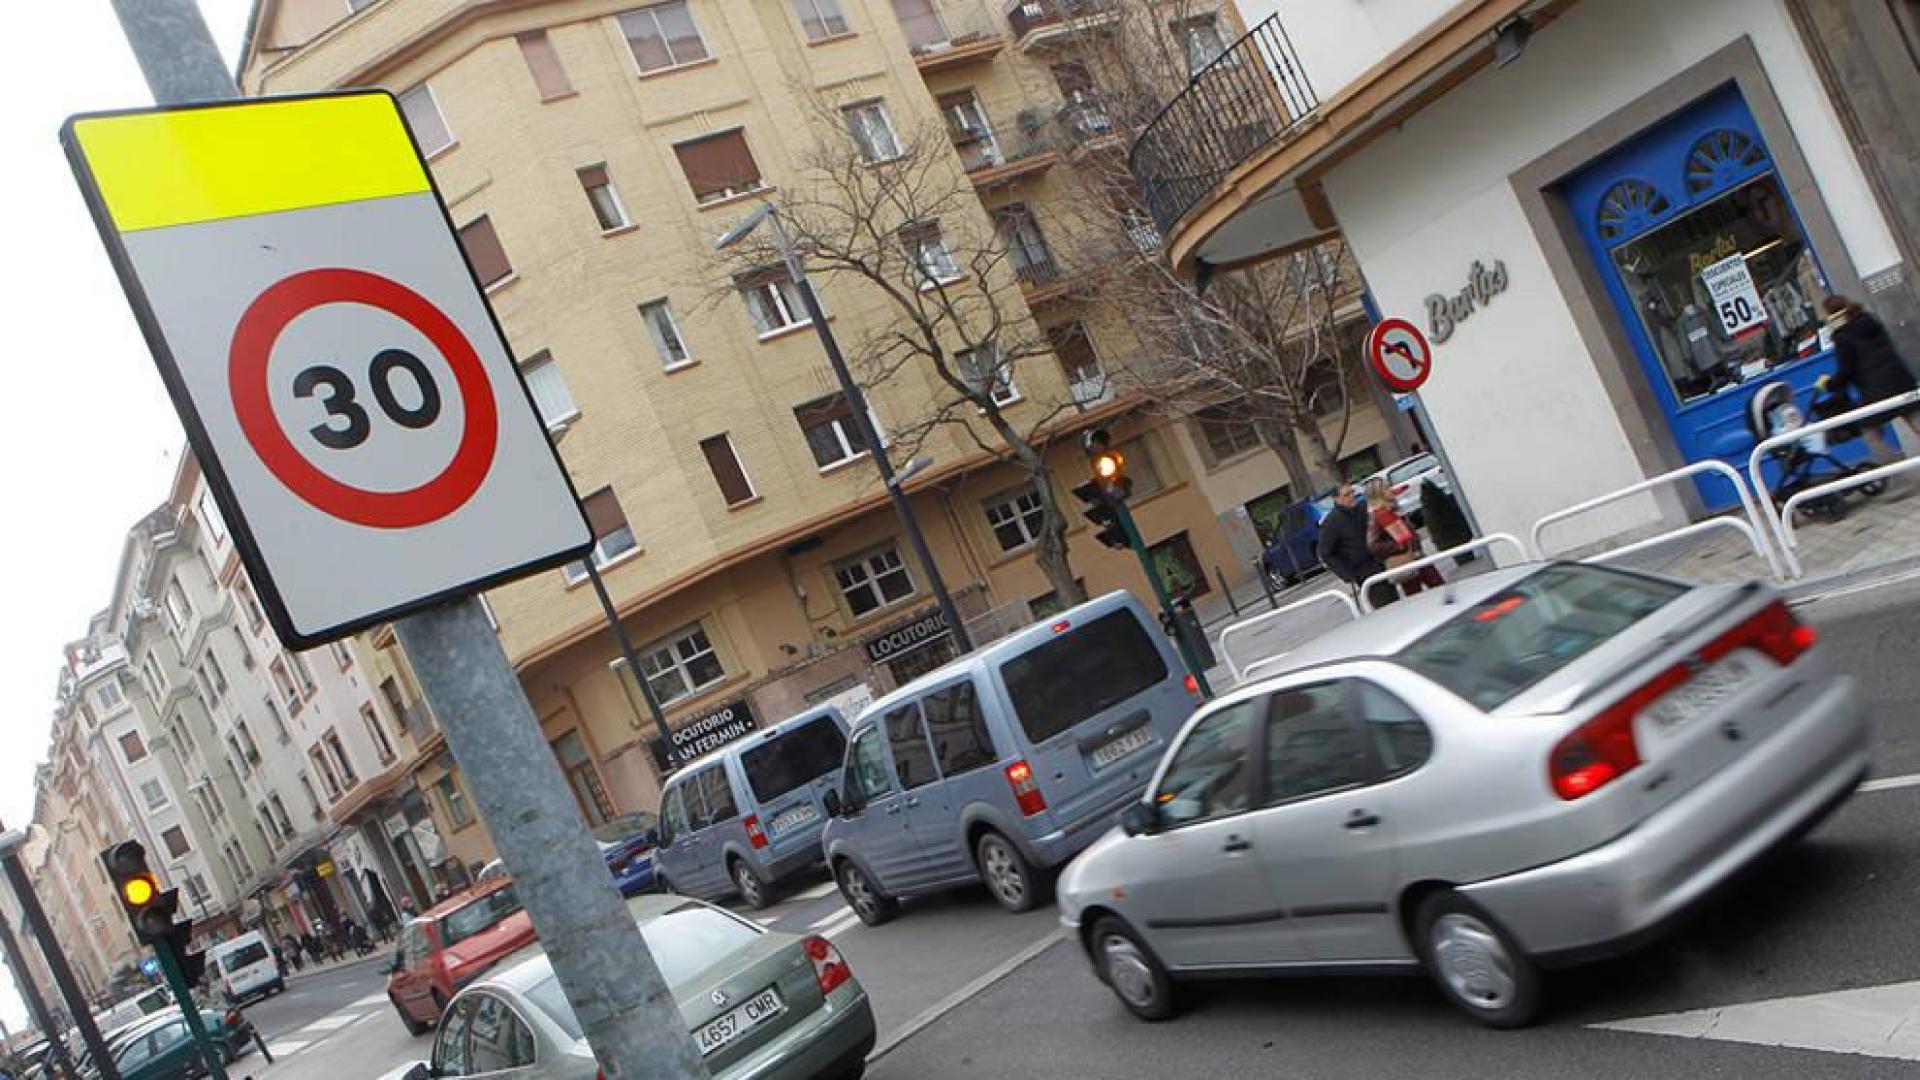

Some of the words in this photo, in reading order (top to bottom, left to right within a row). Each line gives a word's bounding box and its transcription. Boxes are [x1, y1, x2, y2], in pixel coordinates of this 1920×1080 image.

[293, 348, 441, 450] 30
[672, 708, 734, 746] OCUTORIO
[701, 1013, 736, 1048] 4657
[745, 993, 777, 1019] CMR
